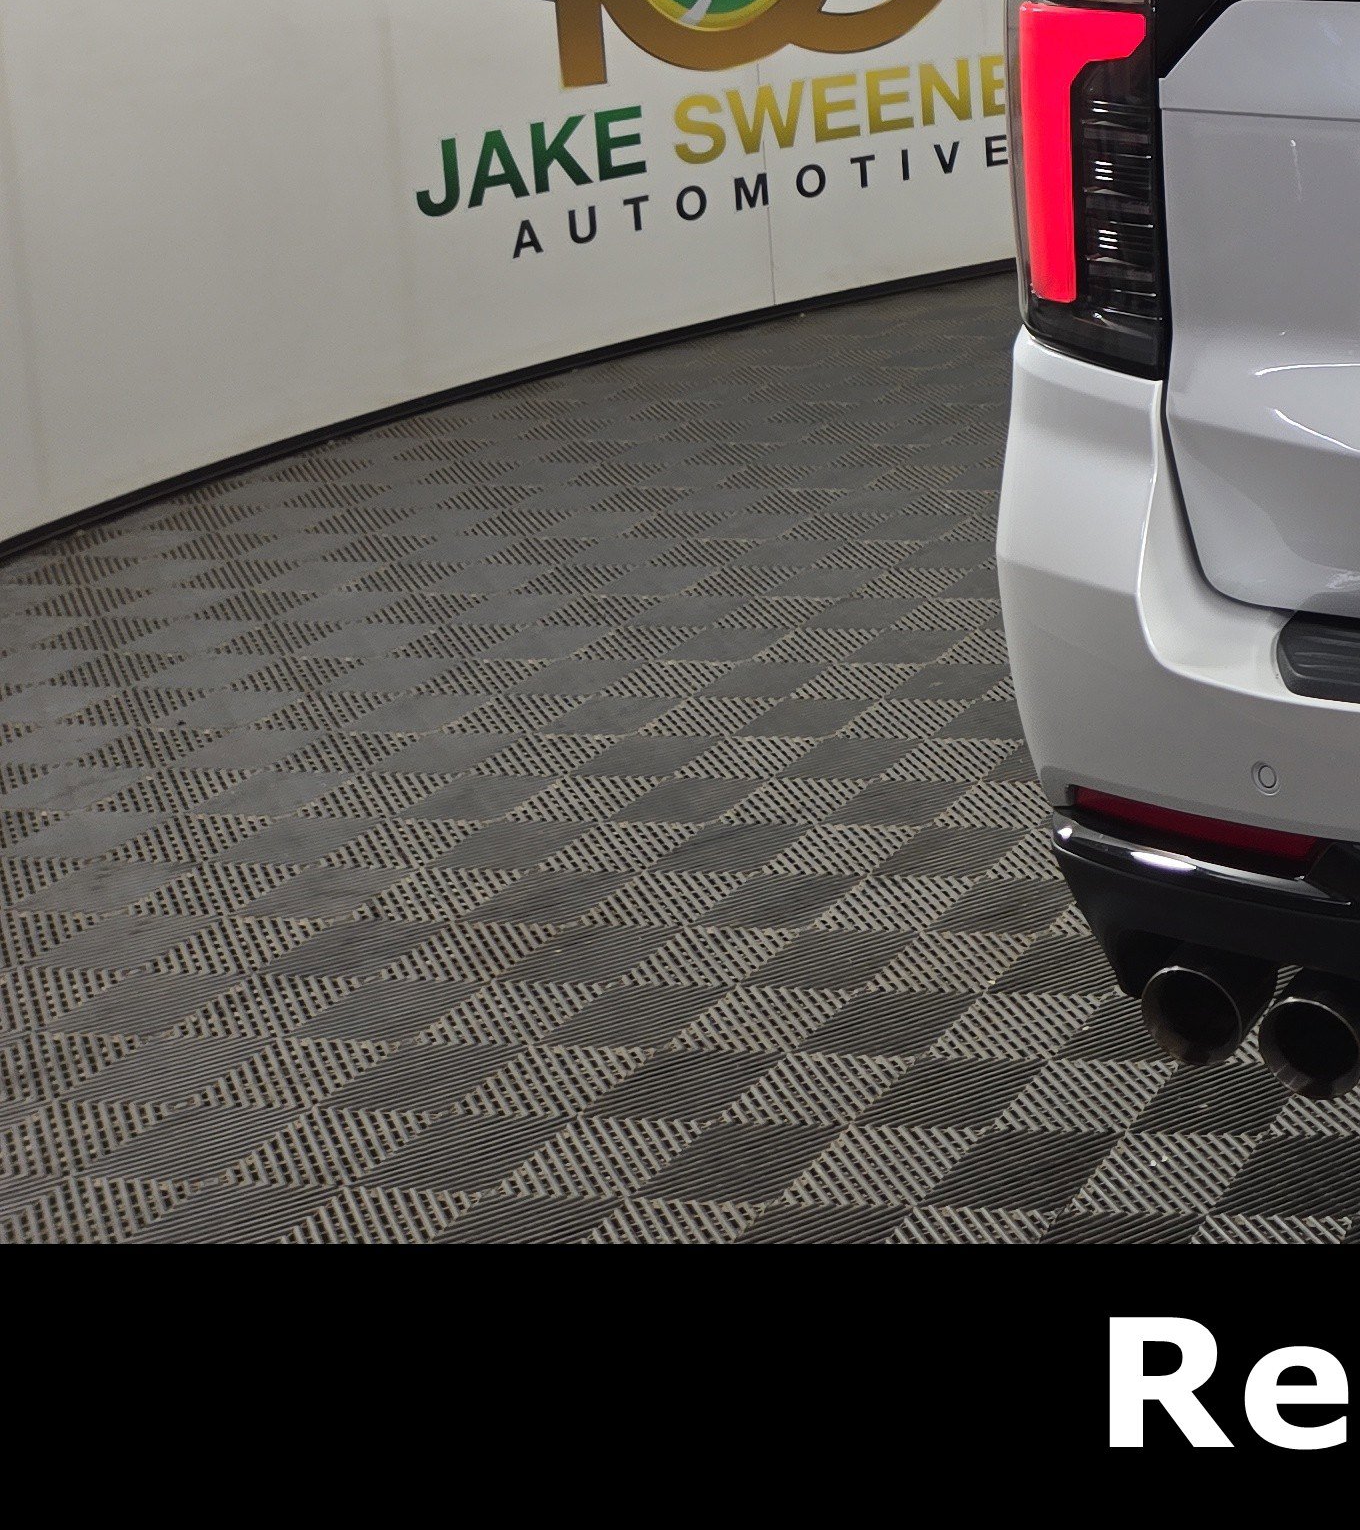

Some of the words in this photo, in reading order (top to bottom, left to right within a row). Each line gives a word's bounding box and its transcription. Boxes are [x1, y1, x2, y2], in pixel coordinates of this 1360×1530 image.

[415, 105, 647, 218] JAKE
[673, 55, 1006, 166] SWEENE
[512, 134, 1009, 259] AUTOMOTIVE
